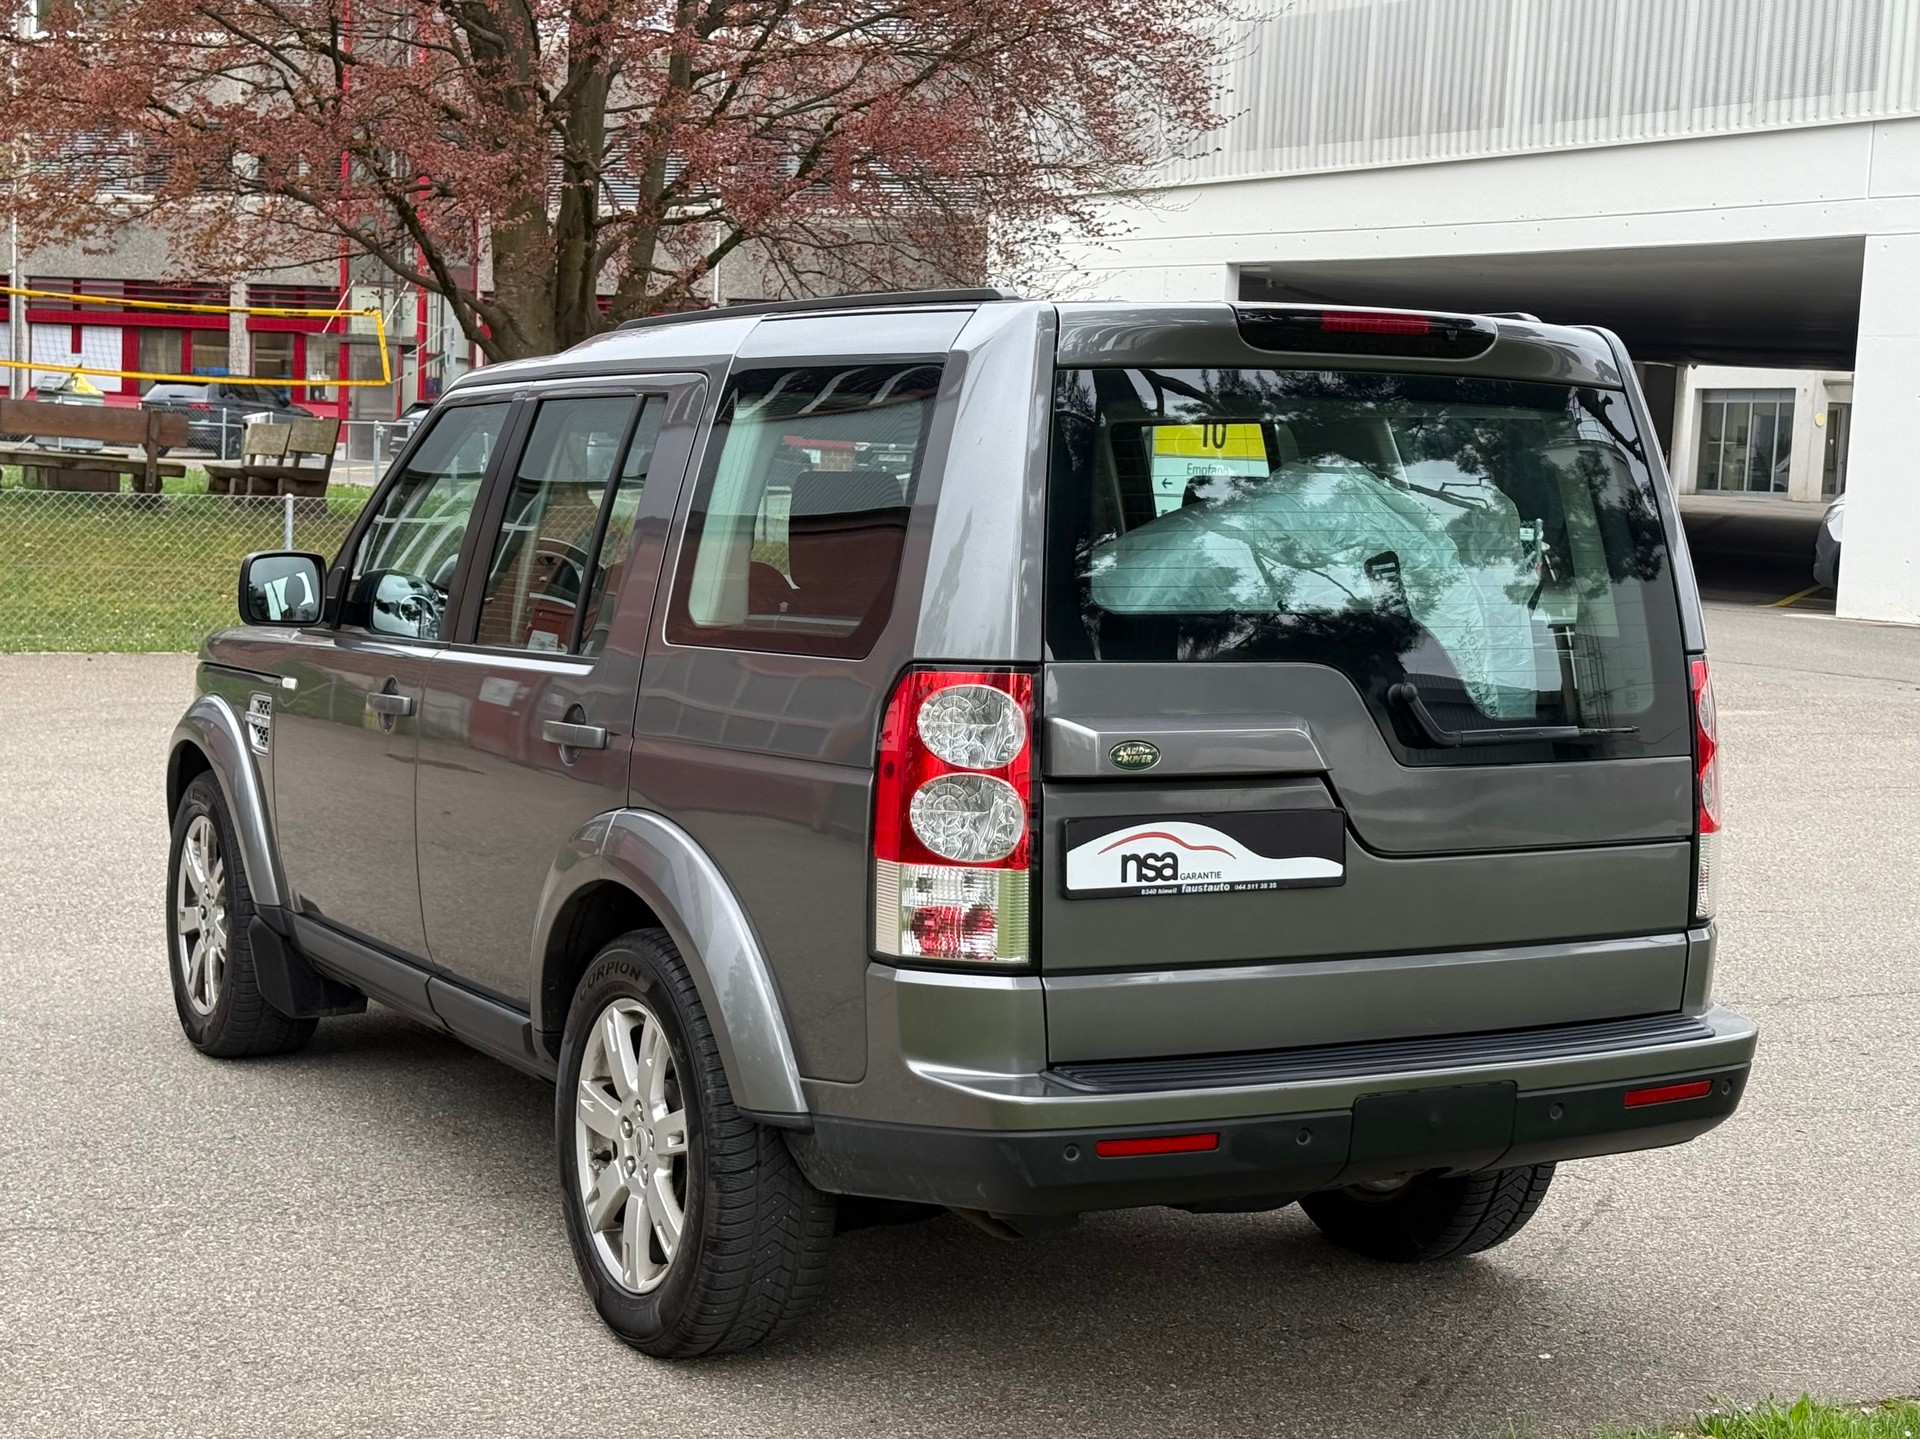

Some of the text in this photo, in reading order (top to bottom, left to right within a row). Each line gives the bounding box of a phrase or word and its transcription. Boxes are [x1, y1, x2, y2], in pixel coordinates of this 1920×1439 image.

[1120, 747, 1145, 755] LAND
[1122, 755, 1153, 763] ROVER
[1121, 852, 1178, 883] nsa
[1180, 871, 1222, 881] GARANTIE
[1181, 882, 1230, 893] faustauto
